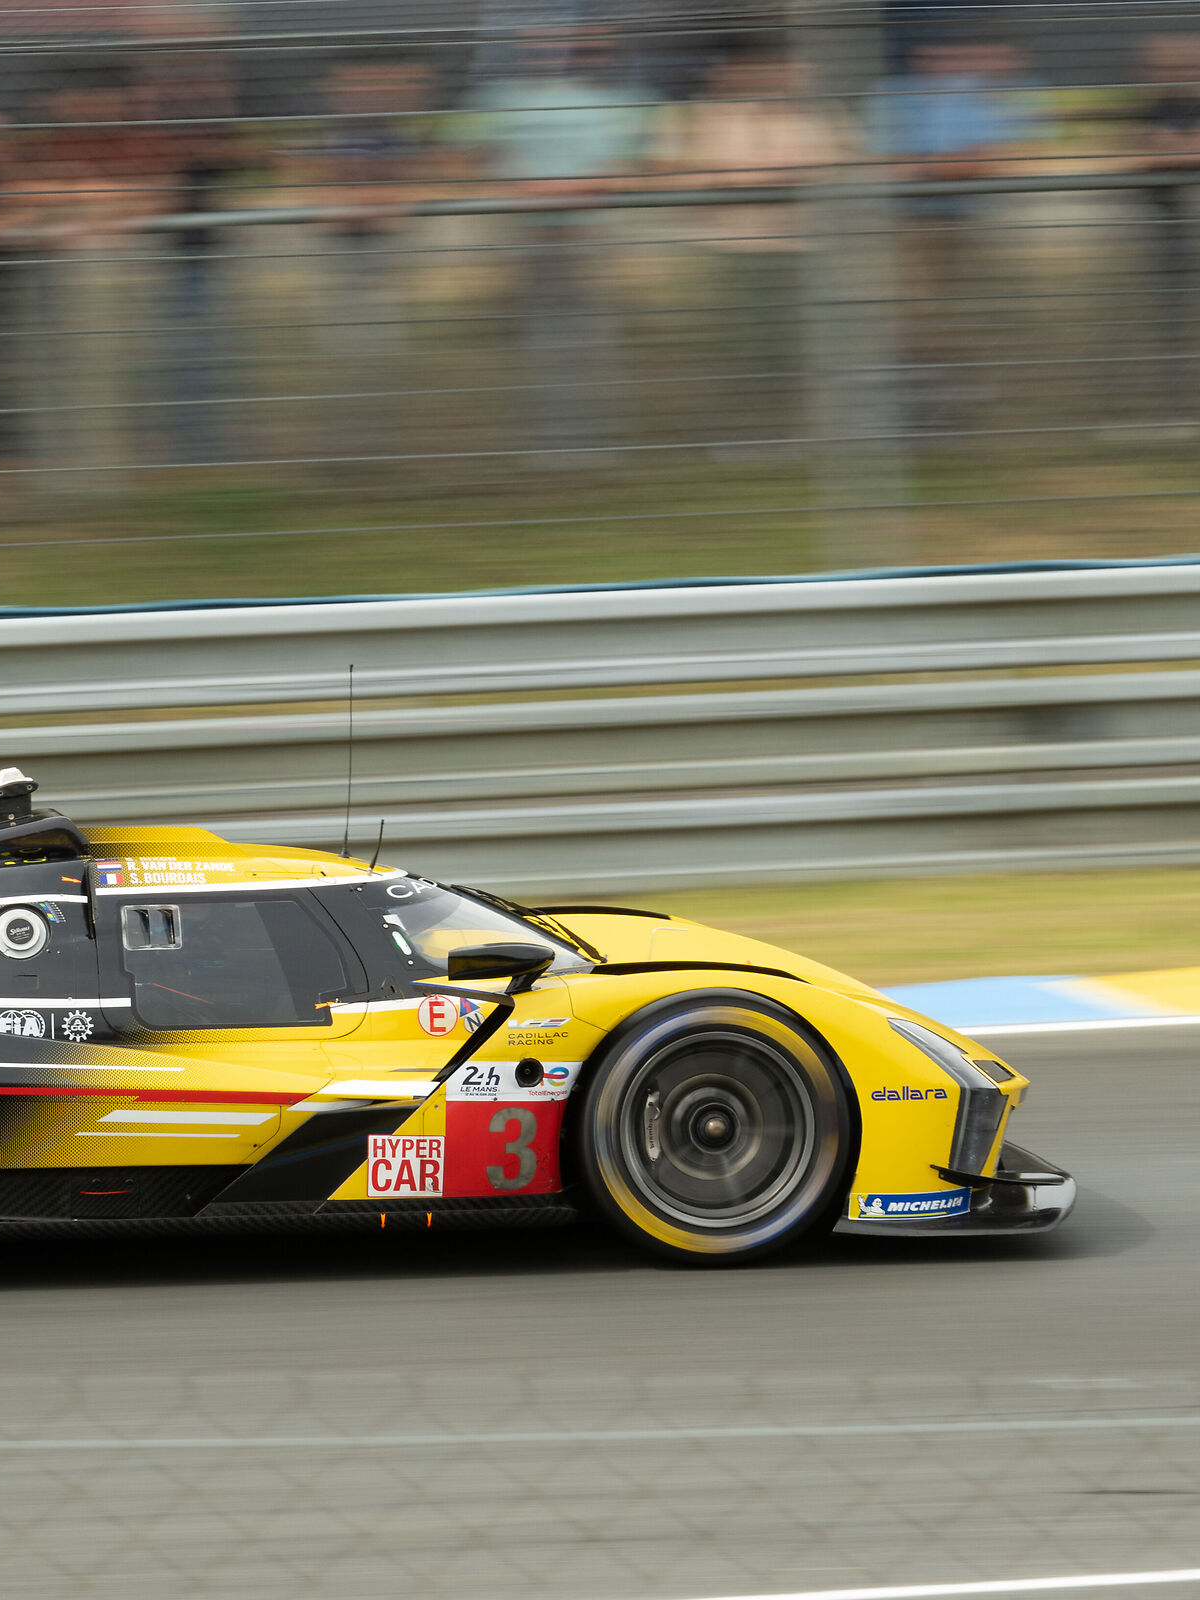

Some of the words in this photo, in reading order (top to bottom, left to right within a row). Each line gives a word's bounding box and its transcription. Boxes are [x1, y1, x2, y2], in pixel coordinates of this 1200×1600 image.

[127, 861, 140, 871] R.
[143, 861, 168, 871] VAN
[169, 861, 193, 871] DER
[195, 862, 236, 872] ZANDE
[129, 872, 143, 884] S.
[144, 872, 207, 884] BOURDAIS
[428, 1000, 447, 1033] E
[466, 1013, 482, 1032] N
[508, 1031, 569, 1040] CADILLAC
[462, 1066, 500, 1086] 24h
[528, 1089, 568, 1097] TotalEnergies
[871, 1085, 948, 1101] dallara
[372, 1138, 442, 1159] HYPER
[486, 1107, 538, 1191] 3
[371, 1158, 440, 1192] CAR
[887, 1196, 964, 1212] MICHELIN
